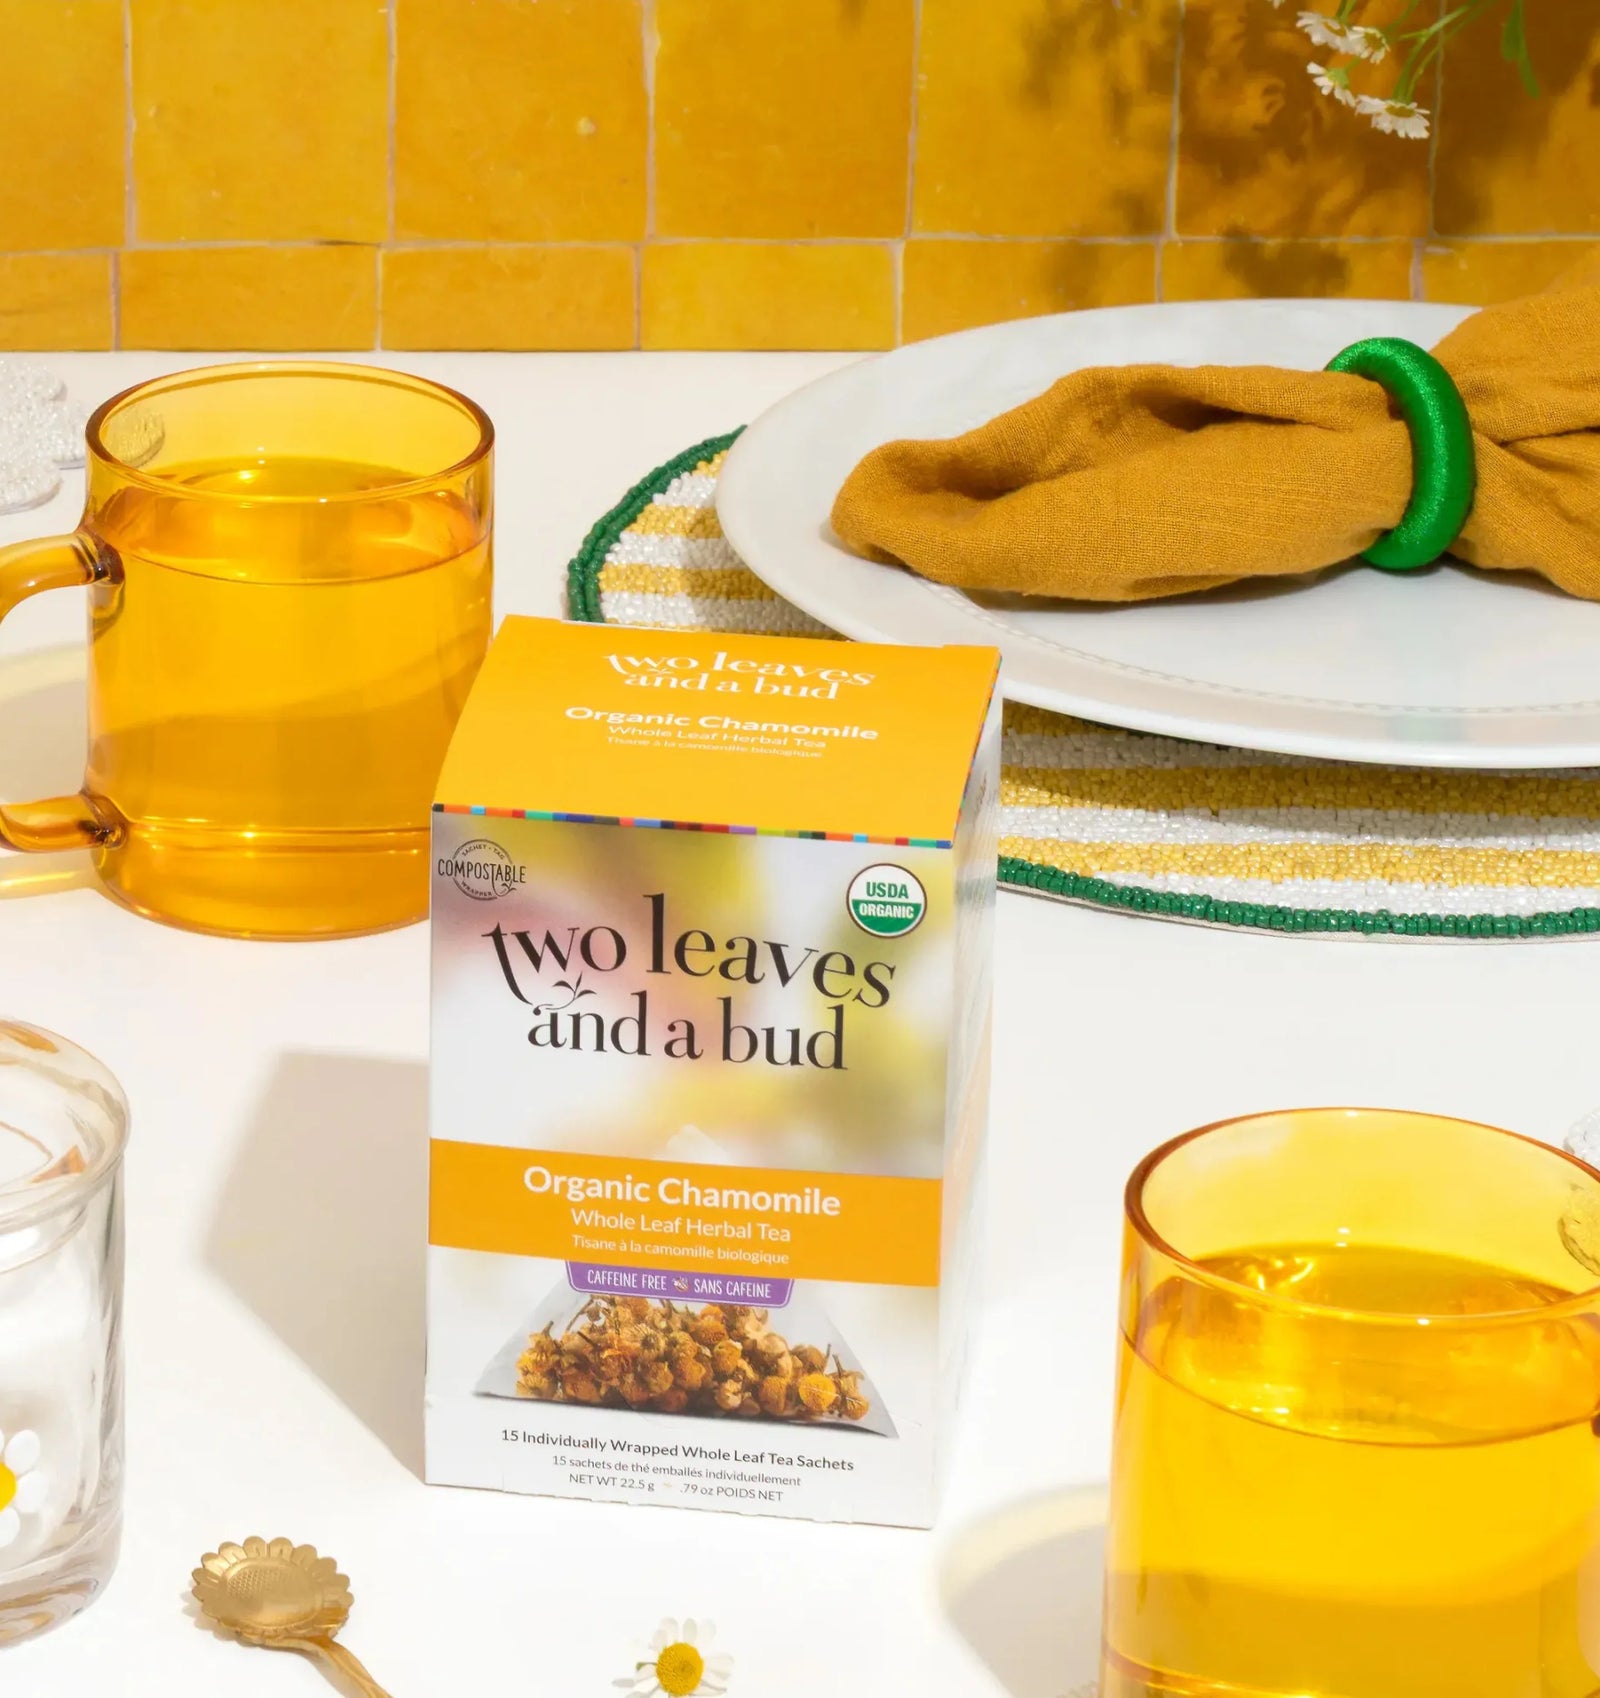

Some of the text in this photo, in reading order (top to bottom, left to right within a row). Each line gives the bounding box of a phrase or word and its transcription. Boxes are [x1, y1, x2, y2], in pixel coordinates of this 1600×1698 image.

[602, 651, 876, 686] two leaves
[624, 673, 840, 700] and a bud
[565, 706, 879, 740] Organic Chamomile
[609, 725, 827, 748] Whole Leaf Herbal Tea
[462, 843, 505, 860] SACHET TAG
[437, 858, 527, 889] COMPOSTABLE
[461, 881, 493, 897] WRAPPER
[858, 881, 914, 919] USDA ORGANIC
[481, 892, 896, 1008] two leaves
[527, 990, 848, 1070] and a bud
[523, 1166, 841, 1217] Organic Chamomile
[570, 1207, 792, 1242] Whole Leaf Herbal Tea
[571, 1234, 790, 1265] Tisane à la camomille biologique
[587, 1269, 772, 1299] CAFFEINE FREE SANS CAFEINE
[501, 1429, 854, 1471] 15 Individually Wrapped Whole Leaf Tea Sachets
[552, 1455, 801, 1486] 15 sachets de thé emballés individuellement
[569, 1473, 594, 1485] NET
[597, 1476, 617, 1487] WT
[620, 1477, 645, 1490] 22.5
[647, 1482, 655, 1492] g
[700, 1486, 713, 1495] oz
[716, 1486, 756, 1499] POIDS
[758, 1490, 784, 1501] NET
